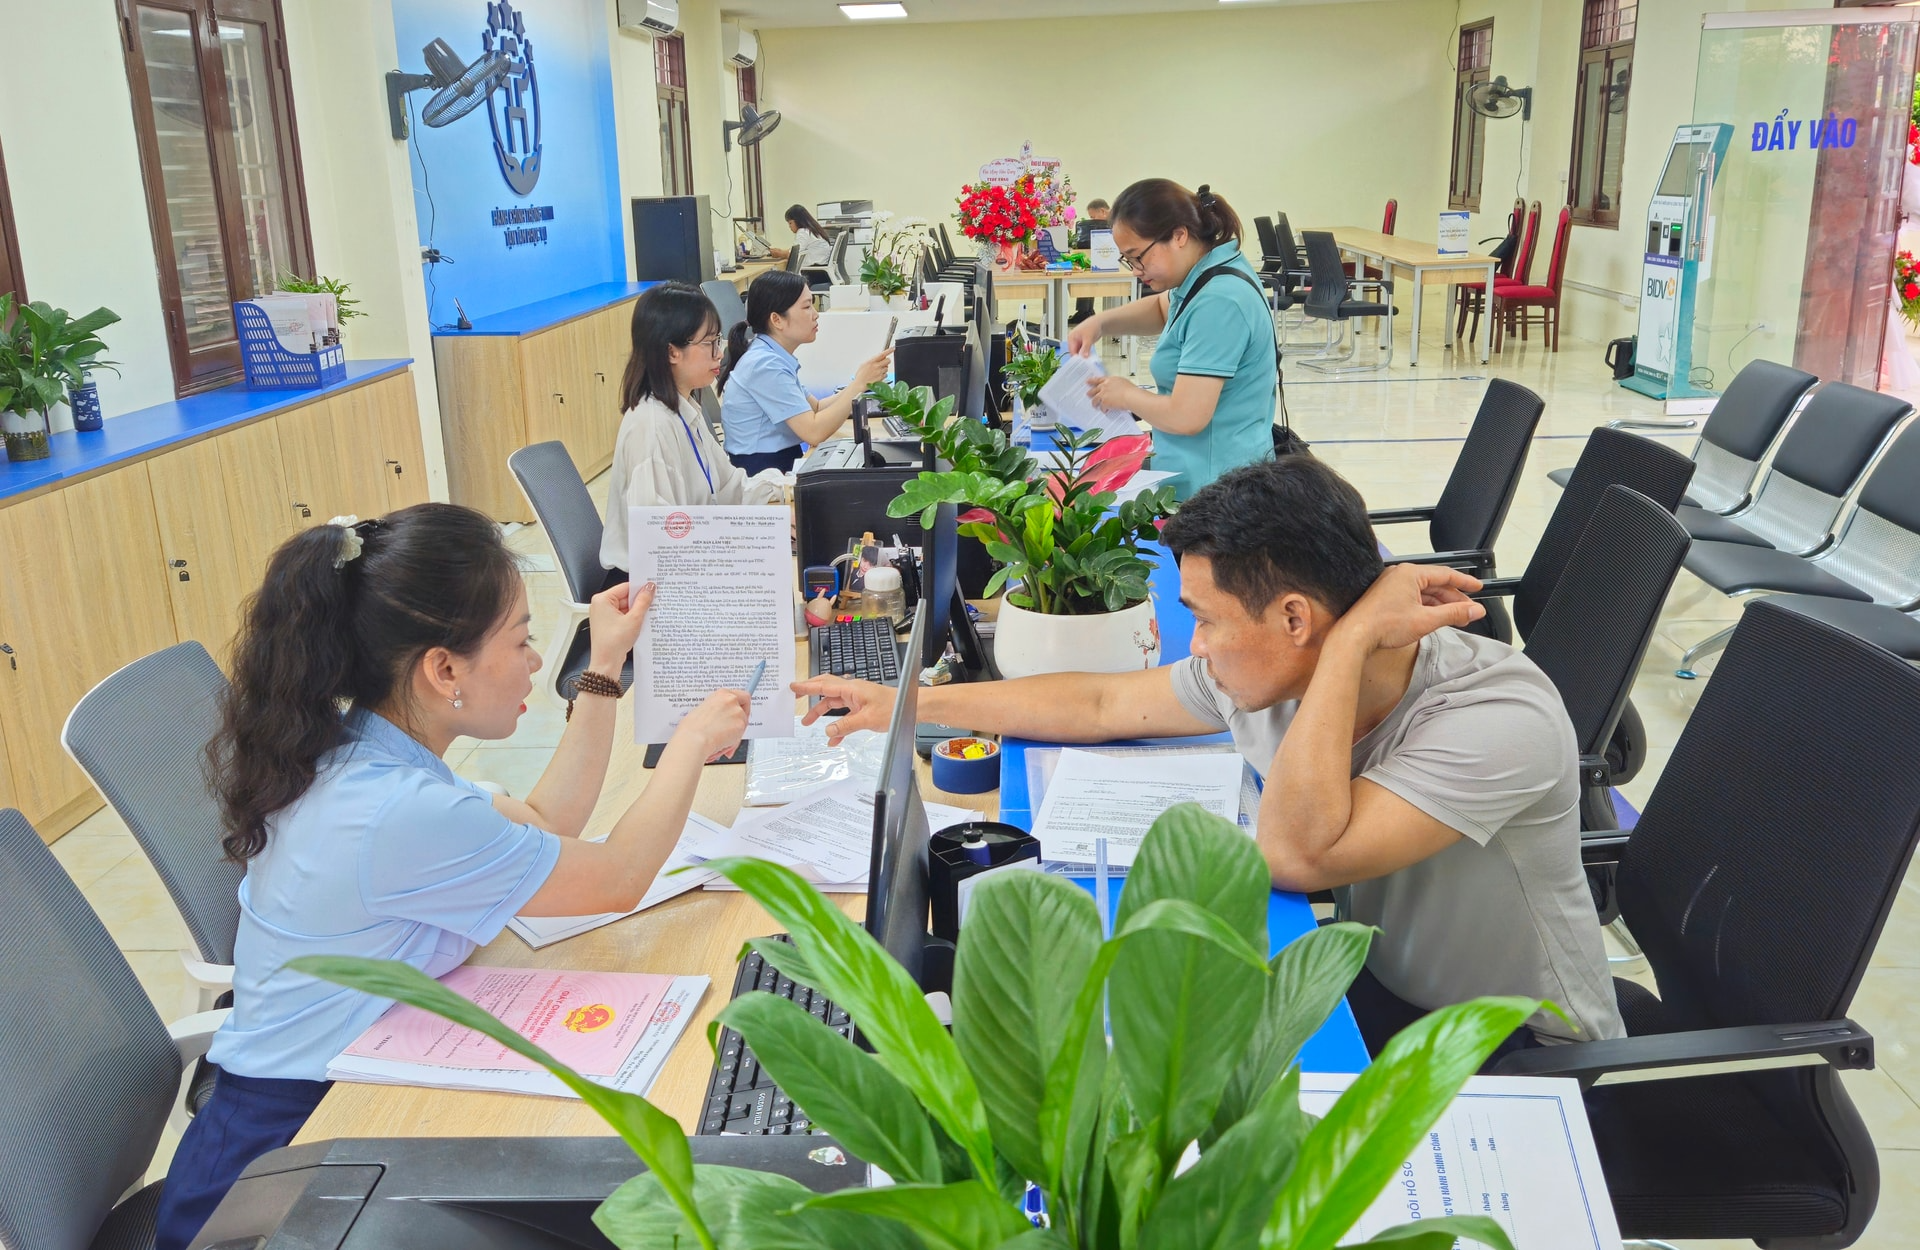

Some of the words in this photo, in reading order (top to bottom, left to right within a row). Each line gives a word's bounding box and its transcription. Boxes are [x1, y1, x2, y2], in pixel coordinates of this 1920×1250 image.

[1752, 108, 1802, 152] ĐẨY
[1810, 112, 1857, 149] VÀO
[1647, 278, 1668, 299] BIDV
[756, 1092, 766, 1111] GOLDEN
[754, 1111, 762, 1125] FIELD
[1430, 1132, 1441, 1151] CÔNG
[1470, 1138, 1478, 1151] năm
[1488, 1138, 1496, 1151] năm
[1434, 1153, 1446, 1174] CHÍNH
[1438, 1176, 1450, 1195] HÀNH
[1407, 1200, 1421, 1219] DÕI
[1442, 1197, 1453, 1206] VỤ
[1481, 1193, 1491, 1211] tháng
[1500, 1193, 1510, 1211] tháng
